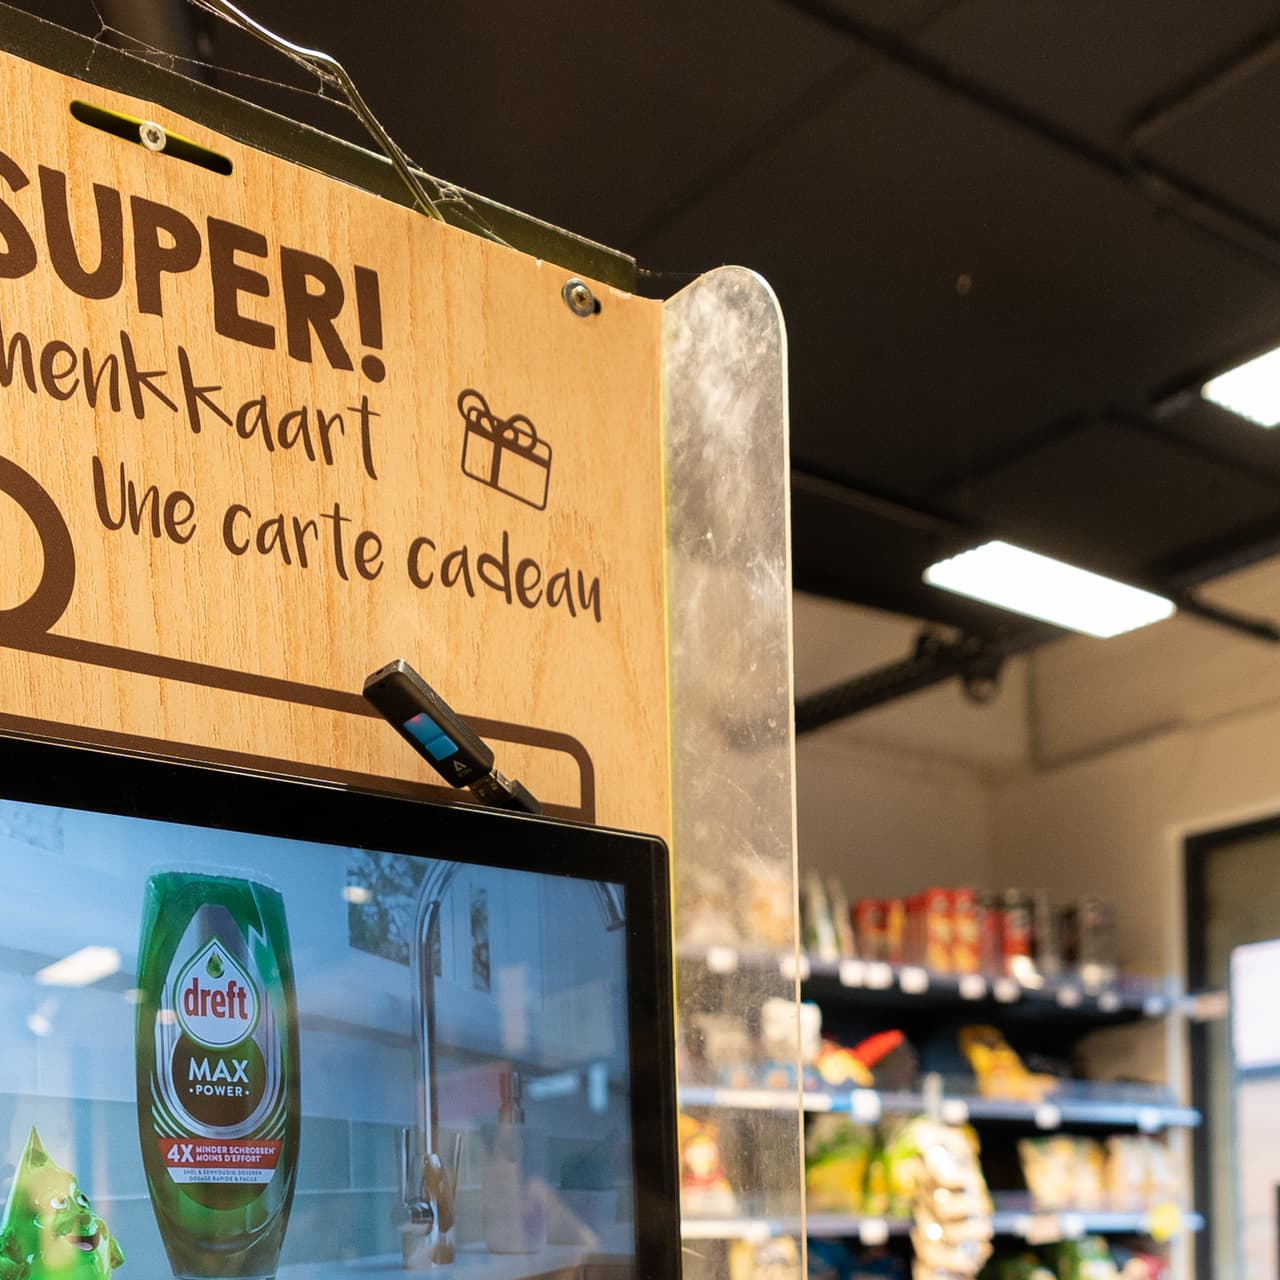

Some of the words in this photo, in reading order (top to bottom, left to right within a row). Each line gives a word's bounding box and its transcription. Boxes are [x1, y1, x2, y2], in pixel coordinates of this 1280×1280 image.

[93, 456, 197, 545] Une
[223, 502, 384, 581] carte
[408, 530, 602, 623] cadeau
[184, 977, 248, 1020] dreft
[188, 1056, 249, 1083] MAX
[195, 1084, 243, 1097] POWER
[167, 1143, 195, 1163] 4X
[195, 1145, 227, 1154] MINDER
